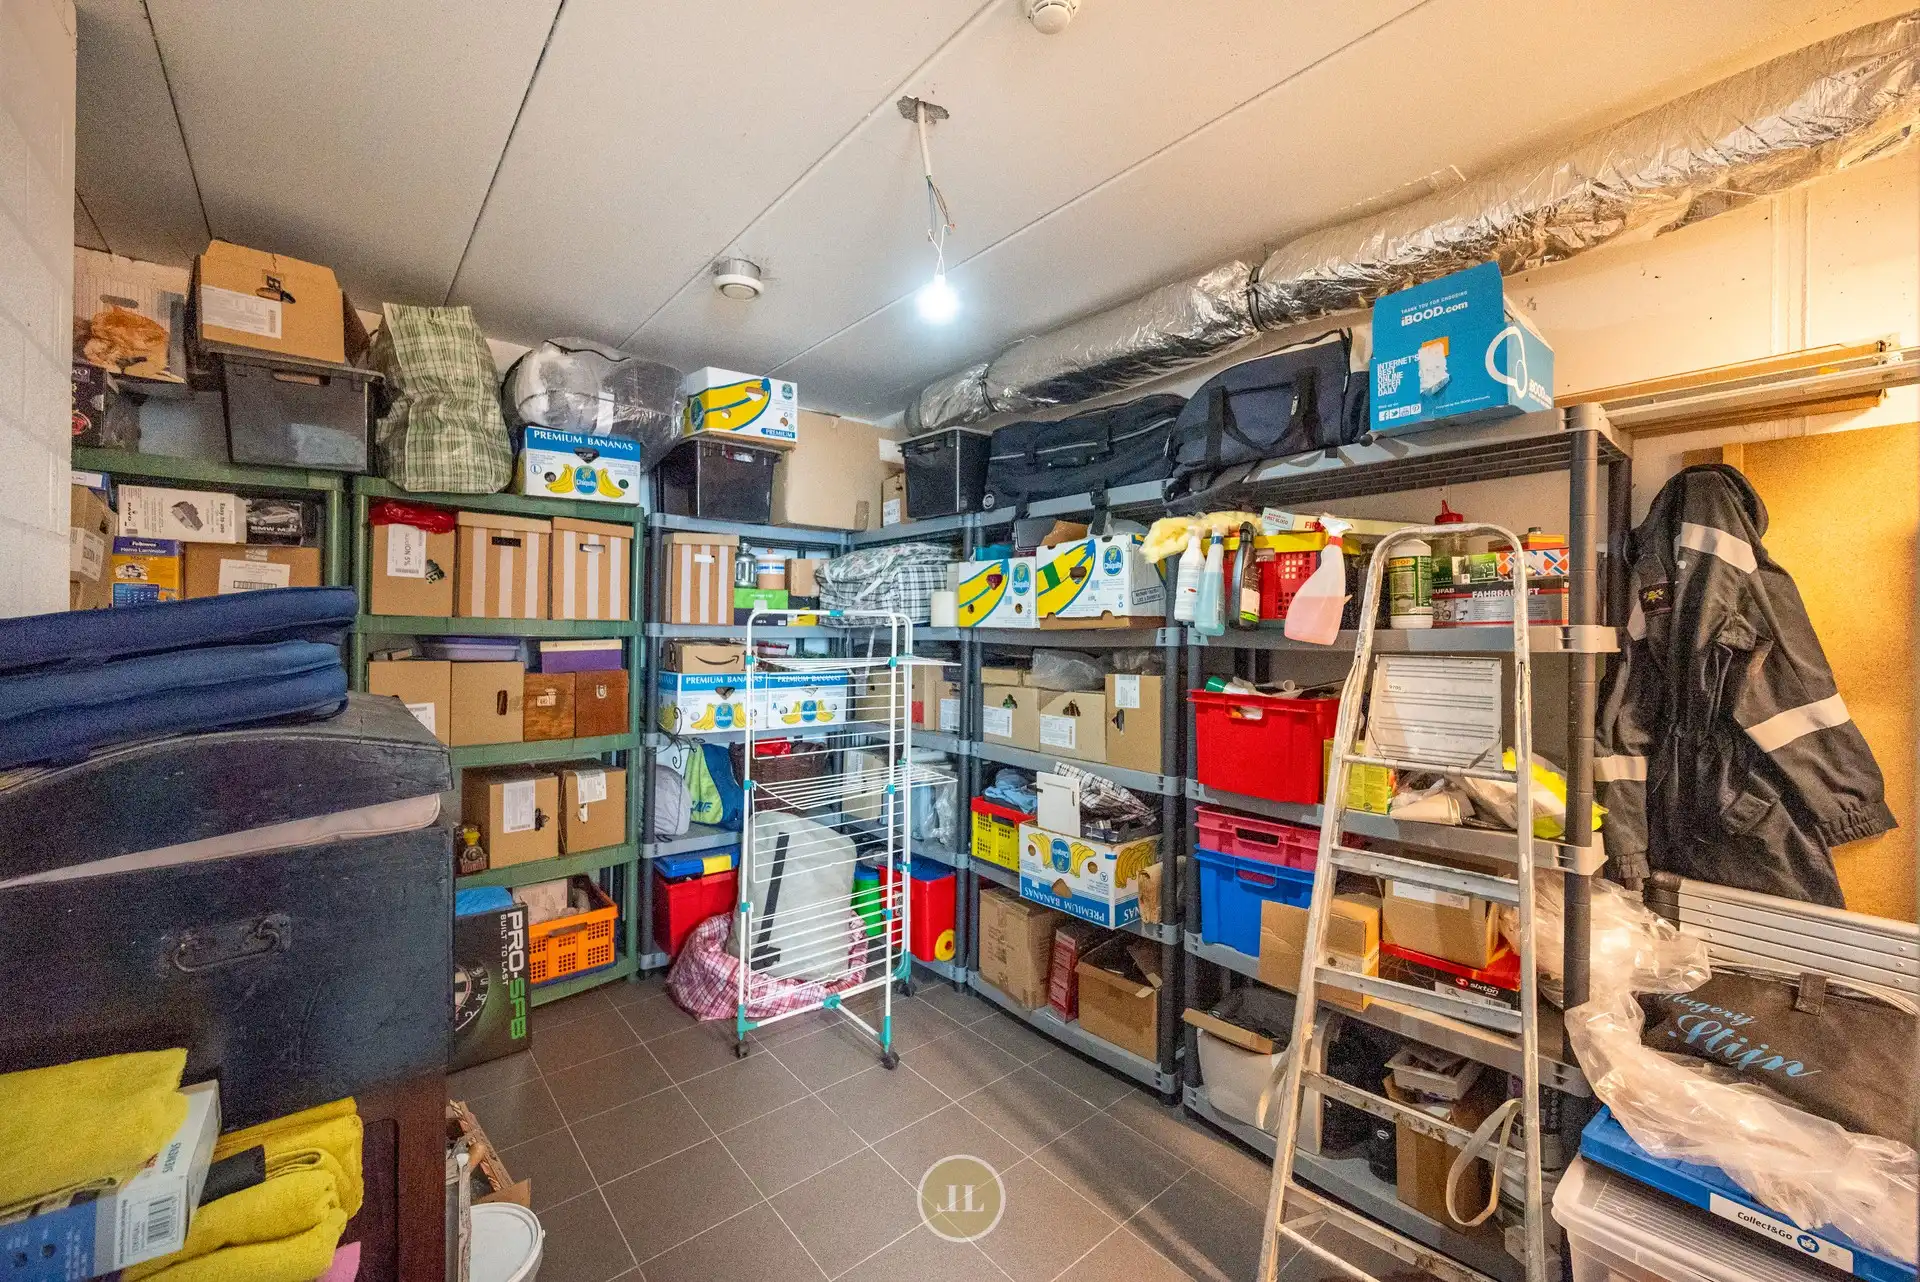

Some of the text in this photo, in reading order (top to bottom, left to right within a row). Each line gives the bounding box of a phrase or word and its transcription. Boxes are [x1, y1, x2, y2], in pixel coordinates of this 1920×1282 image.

[1401, 301, 1468, 327] iBOOD.com
[1377, 353, 1420, 370] INTERNET'S
[1377, 367, 1396, 378] BEST
[1377, 386, 1397, 397] DAILY
[533, 430, 633, 451] PREMIUM BANANAS
[766, 428, 792, 438] PREMIUM
[686, 676, 723, 685] PREMIUM
[1025, 886, 1060, 906] BANANAS
[1064, 900, 1105, 922] PREMIUM
[501, 944, 508, 957] TO
[501, 962, 509, 986] LAST
[1470, 982, 1499, 995] sixton
[1737, 1211, 1793, 1241] Collect&Go
